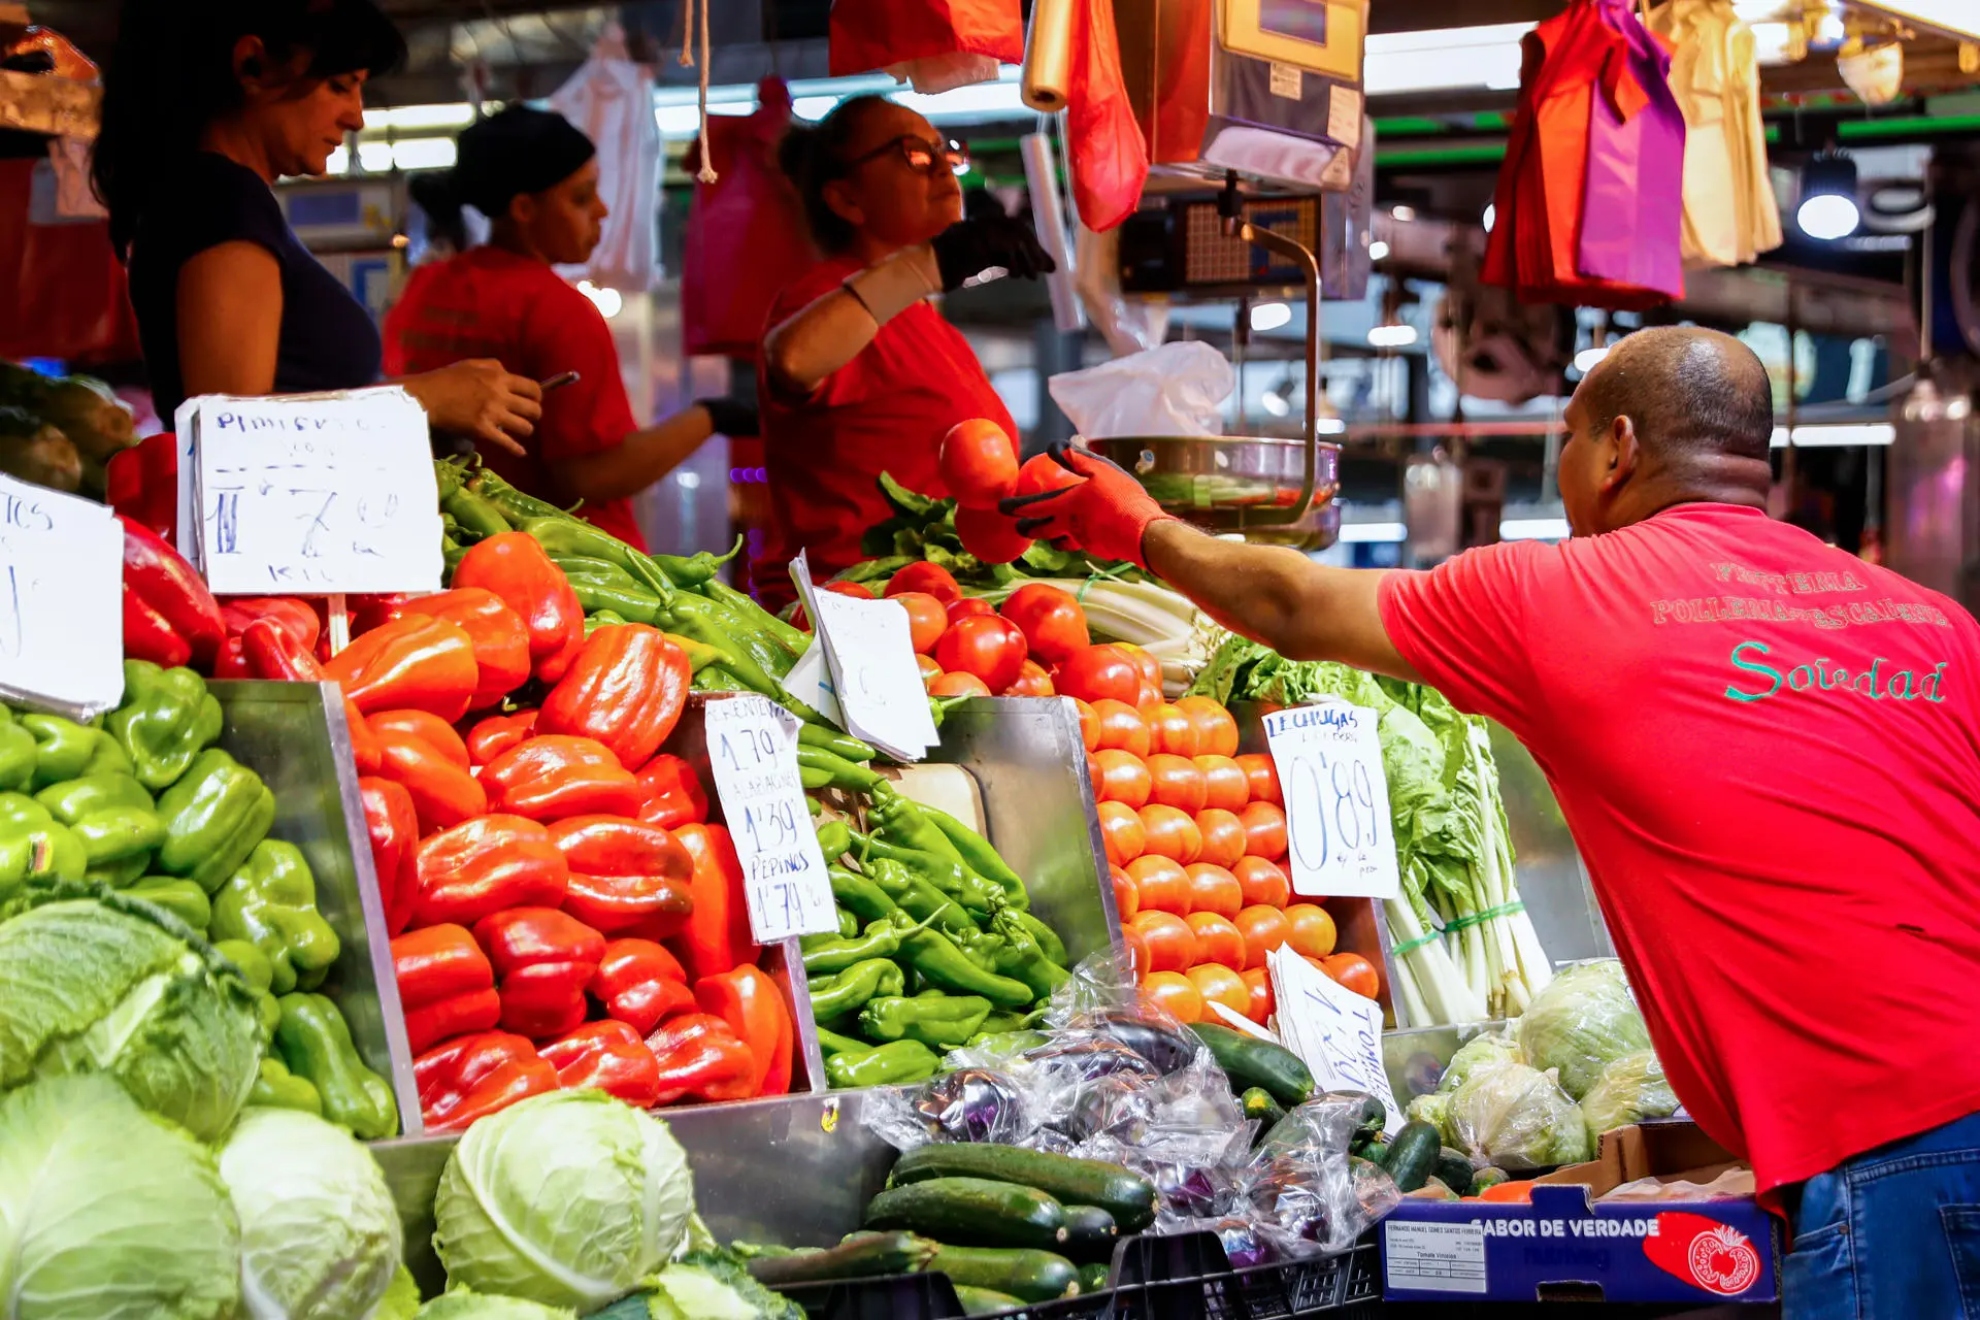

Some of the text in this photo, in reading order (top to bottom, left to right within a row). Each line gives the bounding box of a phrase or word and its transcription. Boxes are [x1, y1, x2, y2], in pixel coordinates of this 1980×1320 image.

[1724, 640, 1948, 702] Soledad
[1290, 751, 1377, 872] 0'89
[1540, 1219, 1565, 1237] DE
[1568, 1218, 1660, 1237] VERDADE
